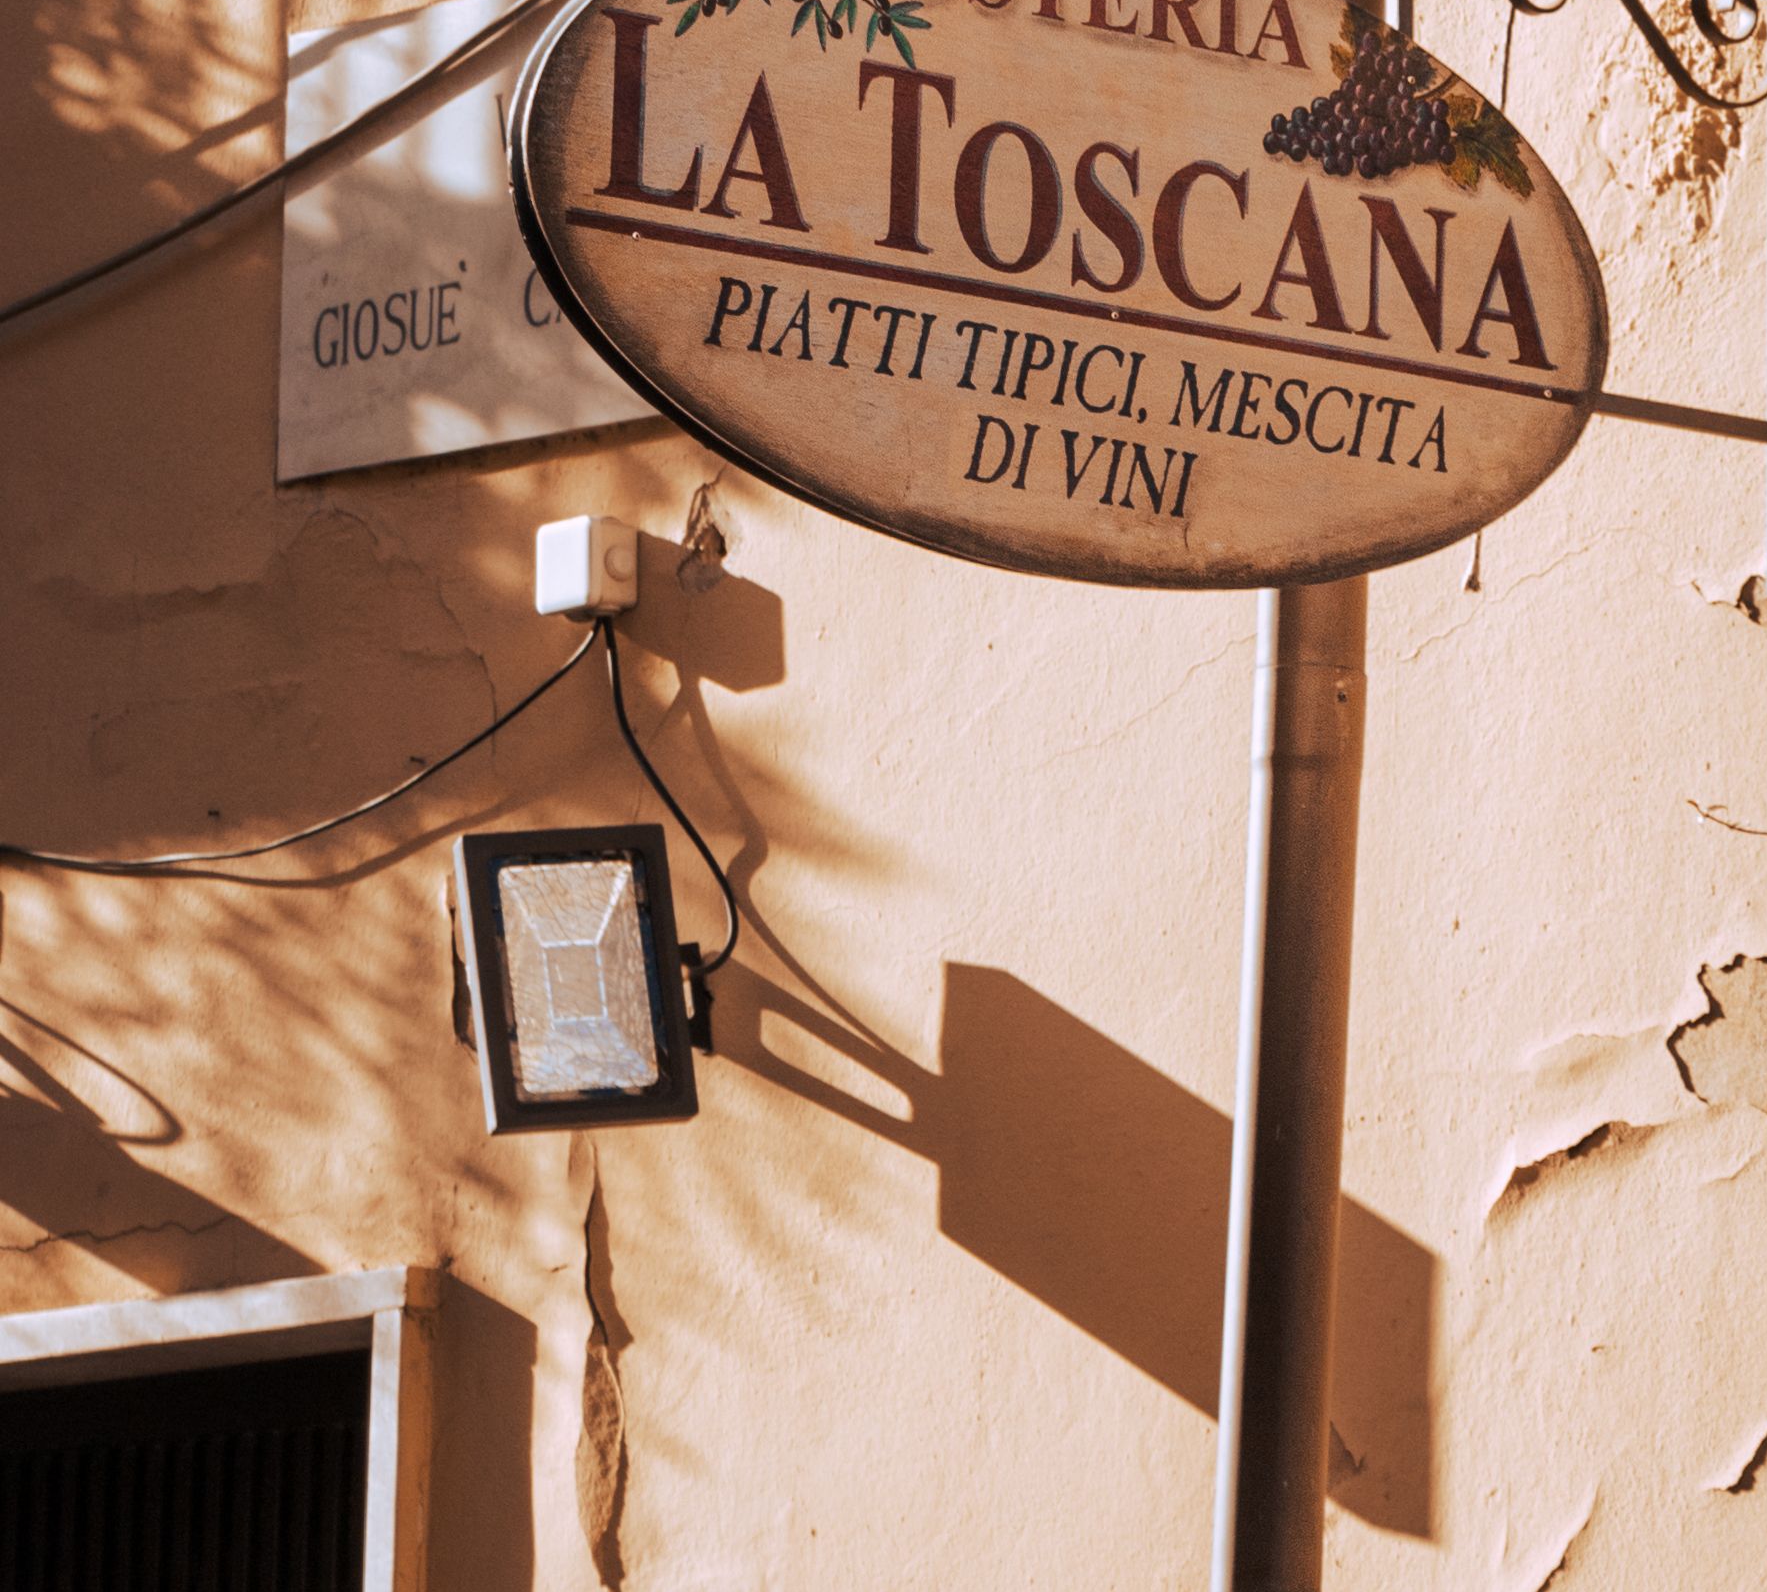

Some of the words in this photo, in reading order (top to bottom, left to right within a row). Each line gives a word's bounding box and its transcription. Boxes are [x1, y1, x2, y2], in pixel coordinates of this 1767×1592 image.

[593, 9, 812, 232] LA
[858, 61, 1559, 371] TOSCANA
[703, 275, 936, 382] PIATTI
[954, 319, 1149, 427] TIPICI,
[1167, 359, 1449, 474] MESCITA
[965, 414, 1040, 489] DI
[1059, 428, 1199, 518] VINI
